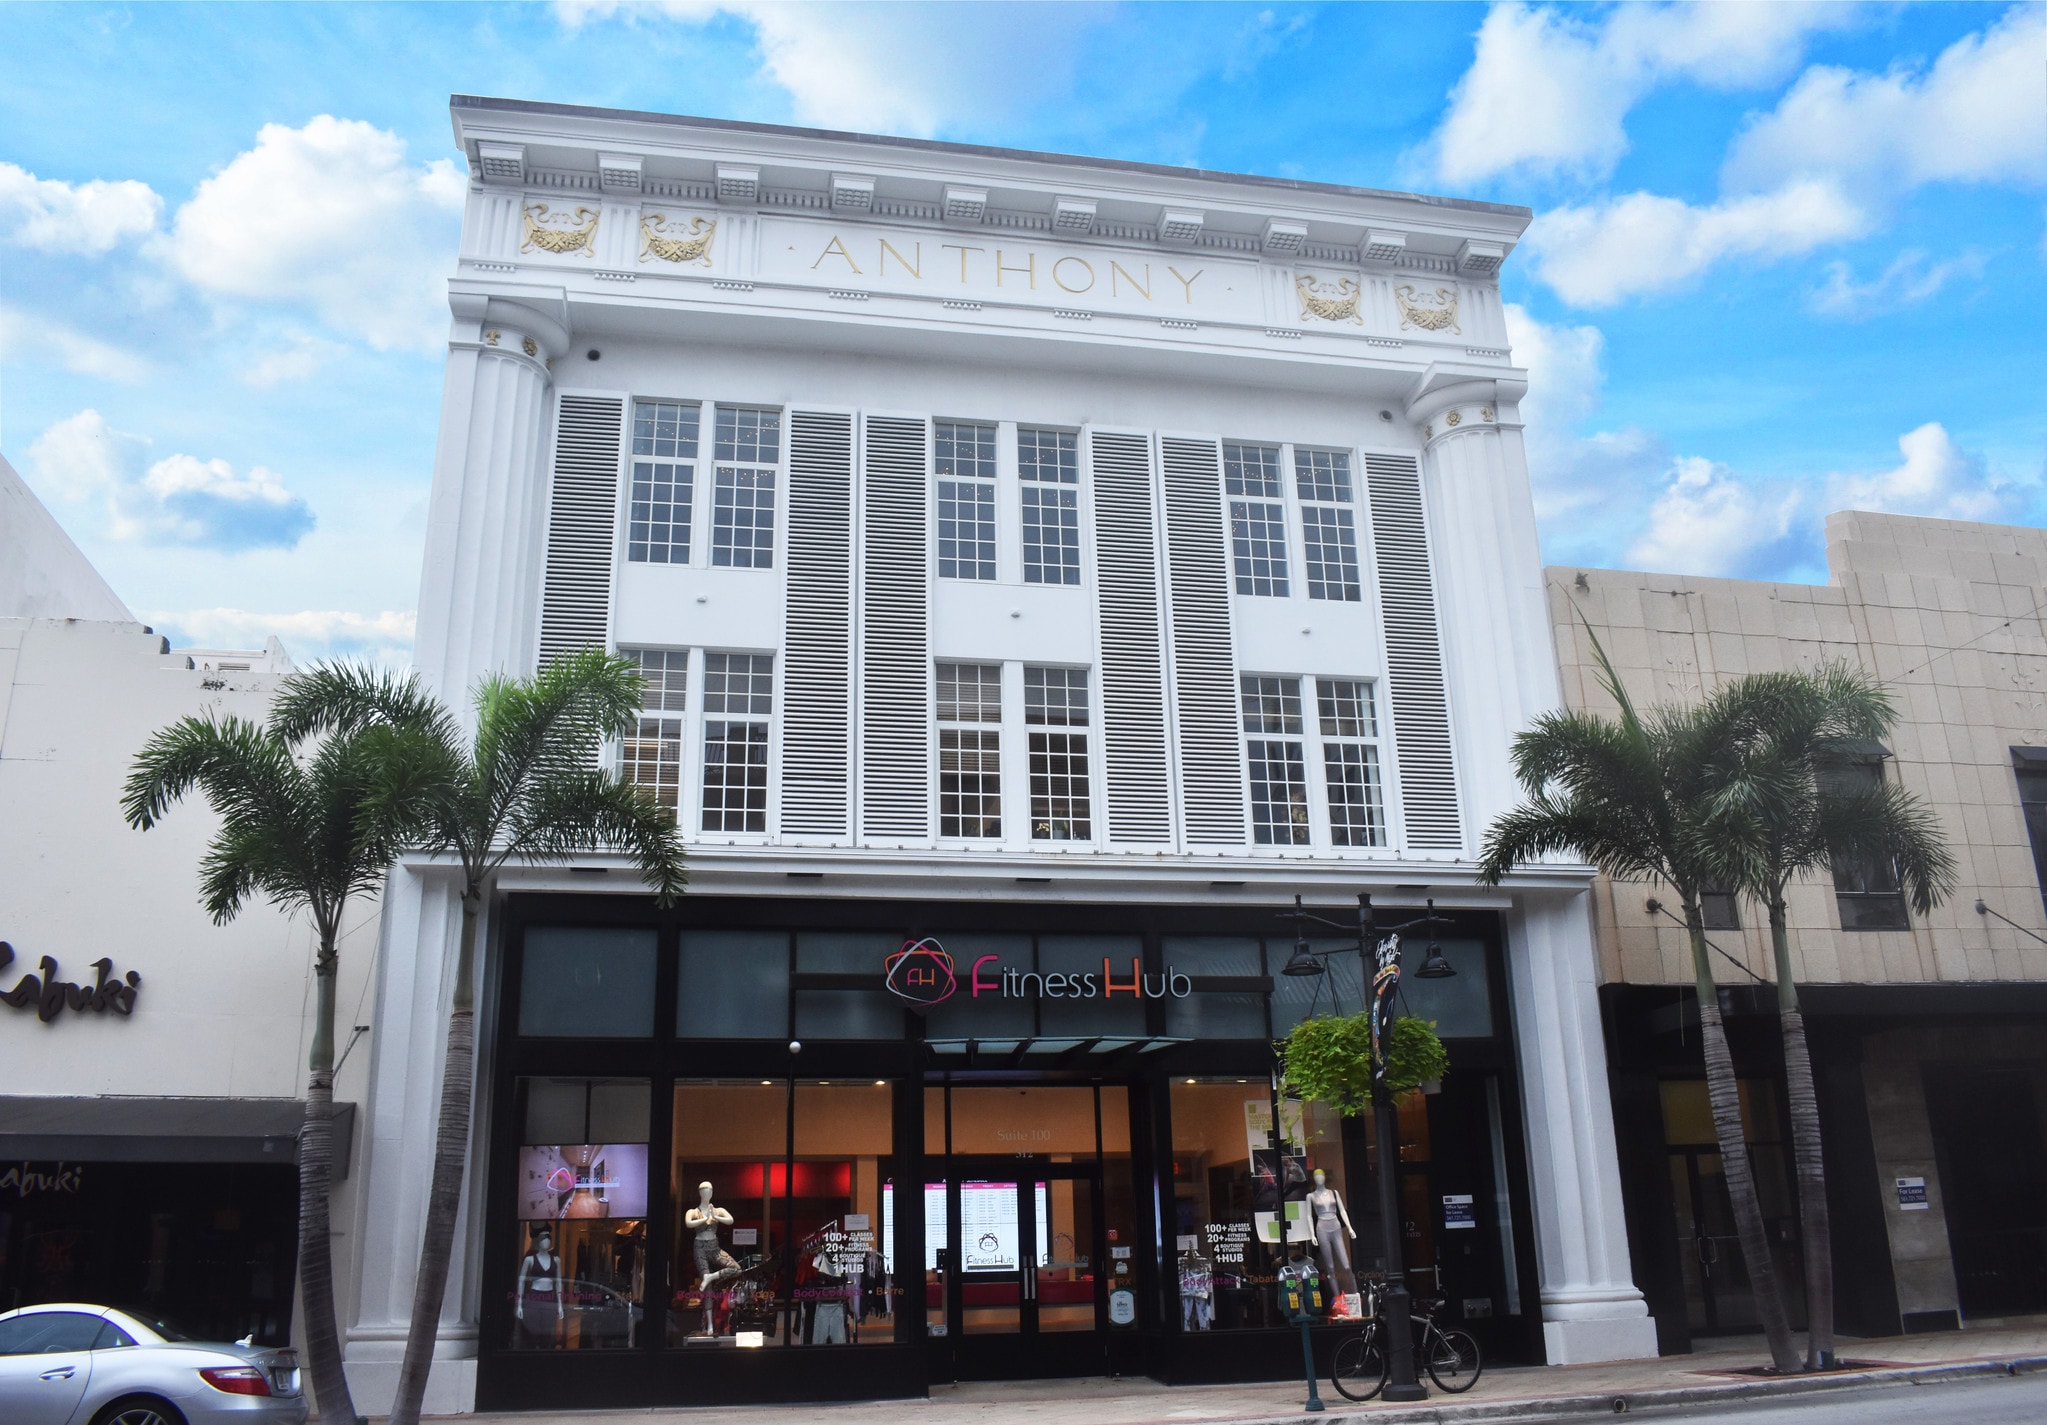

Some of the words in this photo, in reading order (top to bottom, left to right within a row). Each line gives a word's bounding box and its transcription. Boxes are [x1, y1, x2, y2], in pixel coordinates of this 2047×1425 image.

[811, 235, 1203, 304] ANTHONY
[971, 954, 1098, 998] Fitness
[1103, 956, 1192, 998] Hub
[997, 1129, 1028, 1141] Suite
[1032, 1129, 1051, 1140] 100
[1204, 1223, 1227, 1233] 100+
[823, 1232, 848, 1242] 100+
[1207, 1233, 1224, 1243] 20+
[826, 1242, 845, 1252] 20+
[1213, 1244, 1220, 1253] 4
[966, 1254, 994, 1264] Fitness
[995, 1254, 1015, 1264] Hub
[1222, 1253, 1244, 1263] HUB
[841, 1264, 865, 1273] HUB
